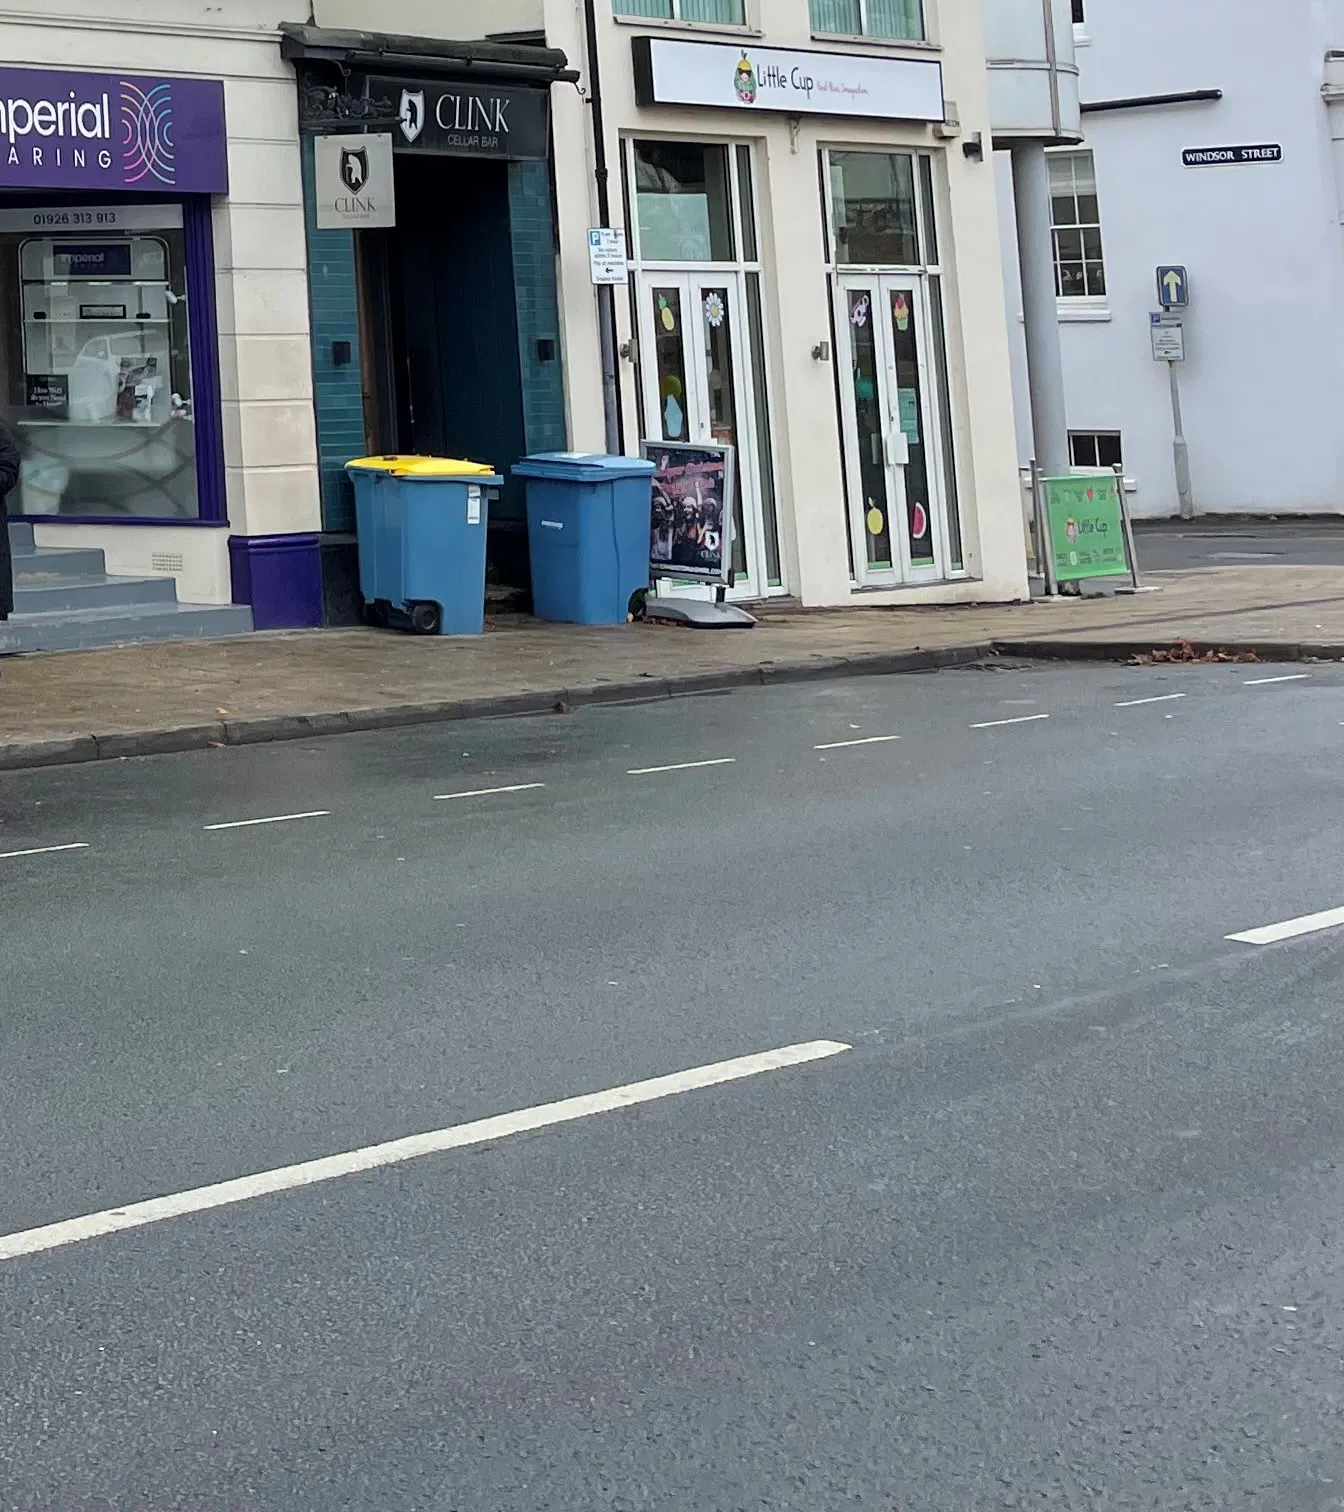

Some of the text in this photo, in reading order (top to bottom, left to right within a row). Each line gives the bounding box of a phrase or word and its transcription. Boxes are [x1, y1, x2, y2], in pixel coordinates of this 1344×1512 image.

[757, 64, 787, 88] Little
[791, 67, 813, 100] Cup
[436, 94, 511, 133] CLINK
[447, 135, 498, 148] CELLAR BAR
[1185, 148, 1279, 162] WINDSOR STREET
[334, 196, 377, 213] CLINK
[33, 212, 116, 225] 01926 313 913
